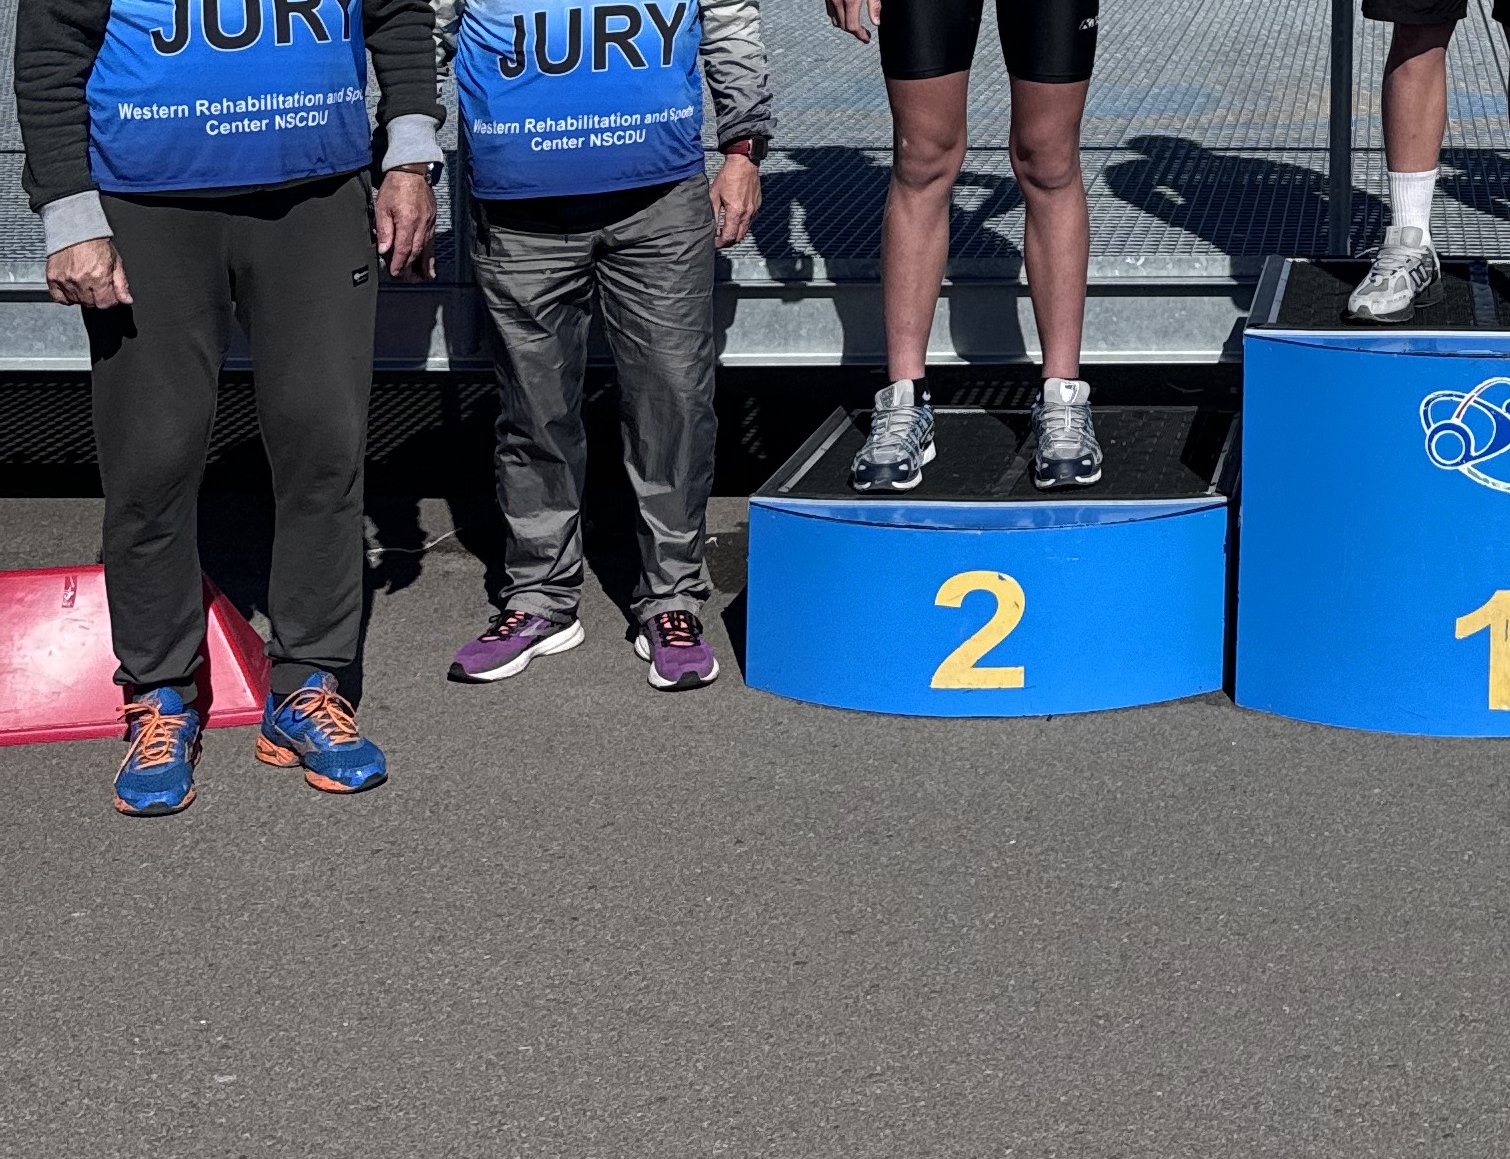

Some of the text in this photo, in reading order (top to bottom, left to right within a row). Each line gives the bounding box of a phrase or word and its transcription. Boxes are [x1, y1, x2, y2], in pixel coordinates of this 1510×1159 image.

[498, 2, 688, 80] JURY
[118, 102, 189, 120] Western
[195, 90, 323, 117] Rehabilitation
[326, 87, 345, 104] and
[205, 109, 329, 136] Center NSCDU
[473, 118, 520, 135] Western
[524, 111, 641, 134] Rehabilitation
[644, 108, 668, 124] and
[531, 129, 646, 151] Center NSCDU
[930, 570, 1026, 689] 2
